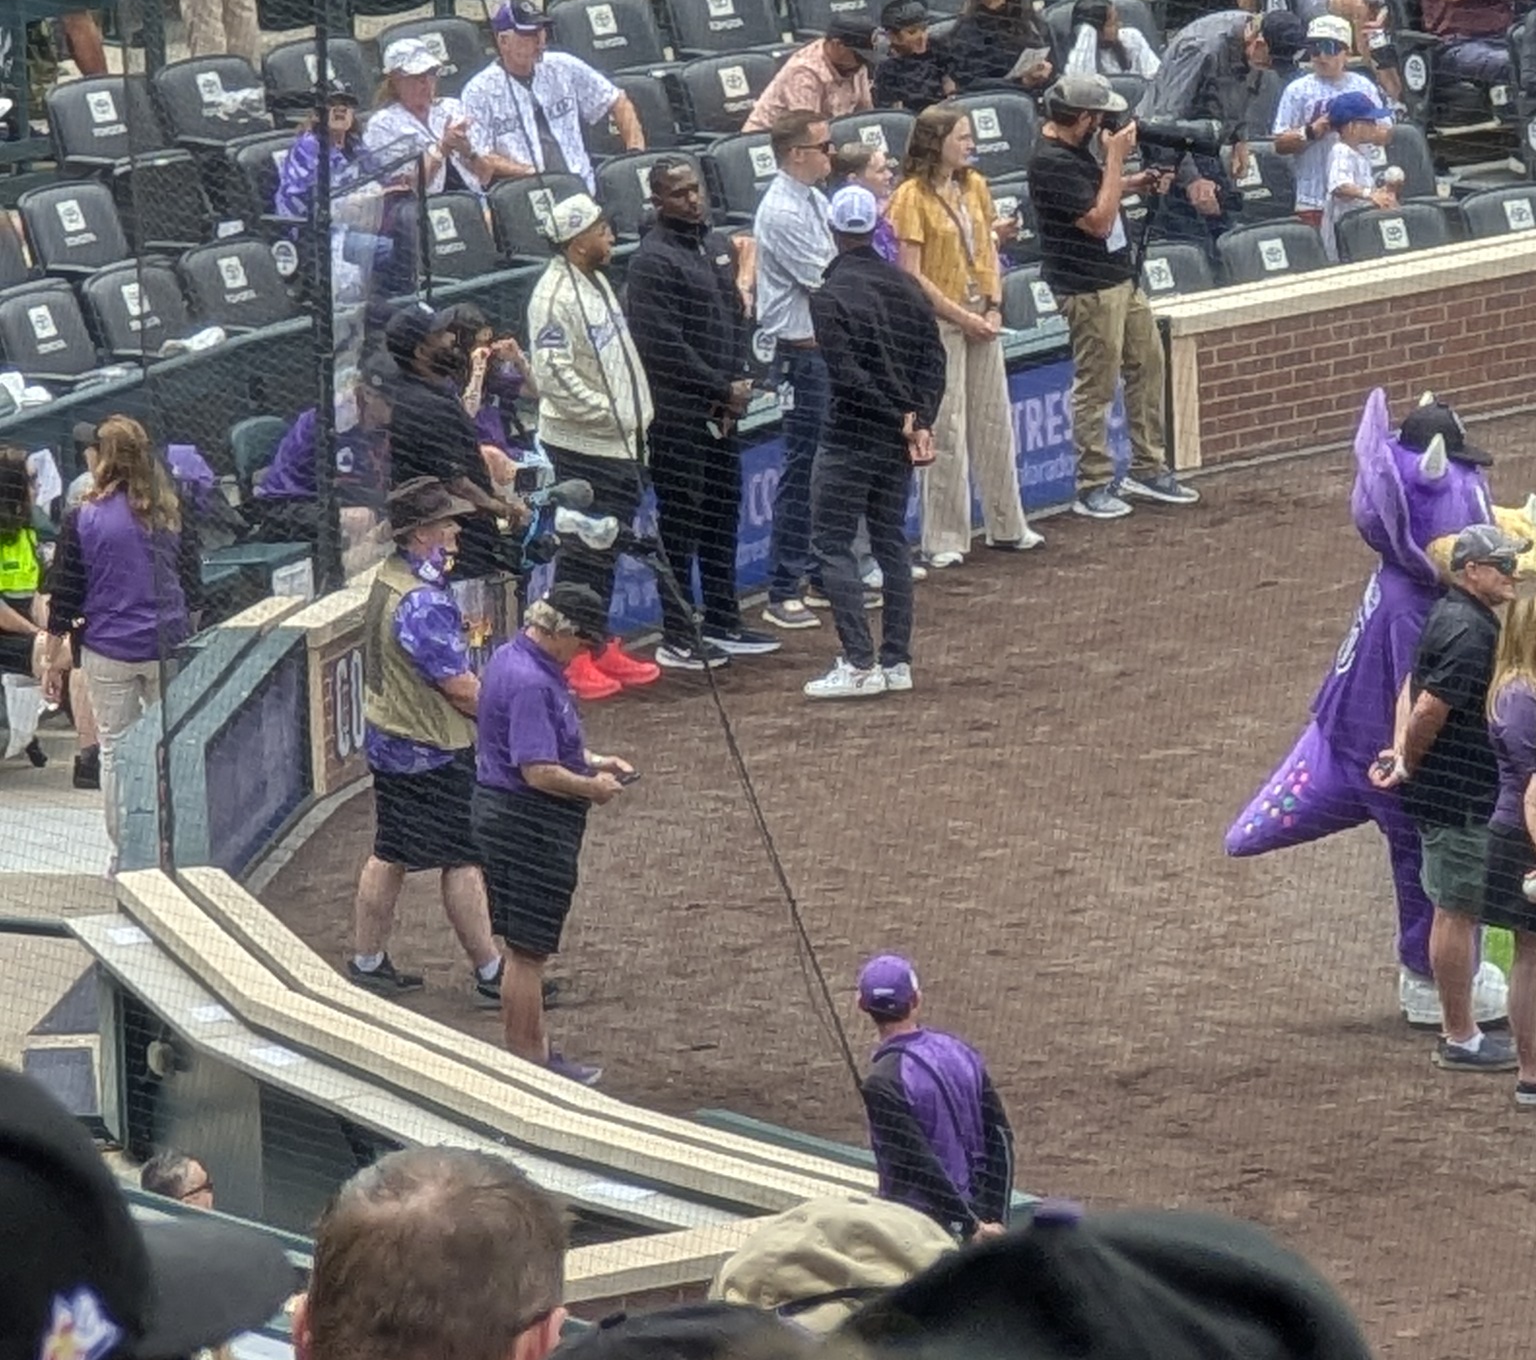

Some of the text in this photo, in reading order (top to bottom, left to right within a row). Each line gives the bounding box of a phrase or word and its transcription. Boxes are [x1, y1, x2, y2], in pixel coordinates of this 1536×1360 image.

[708, 16, 743, 31] TOYOTA
[976, 141, 1010, 156] TOYOTA
[434, 241, 467, 256] TOYOTA
